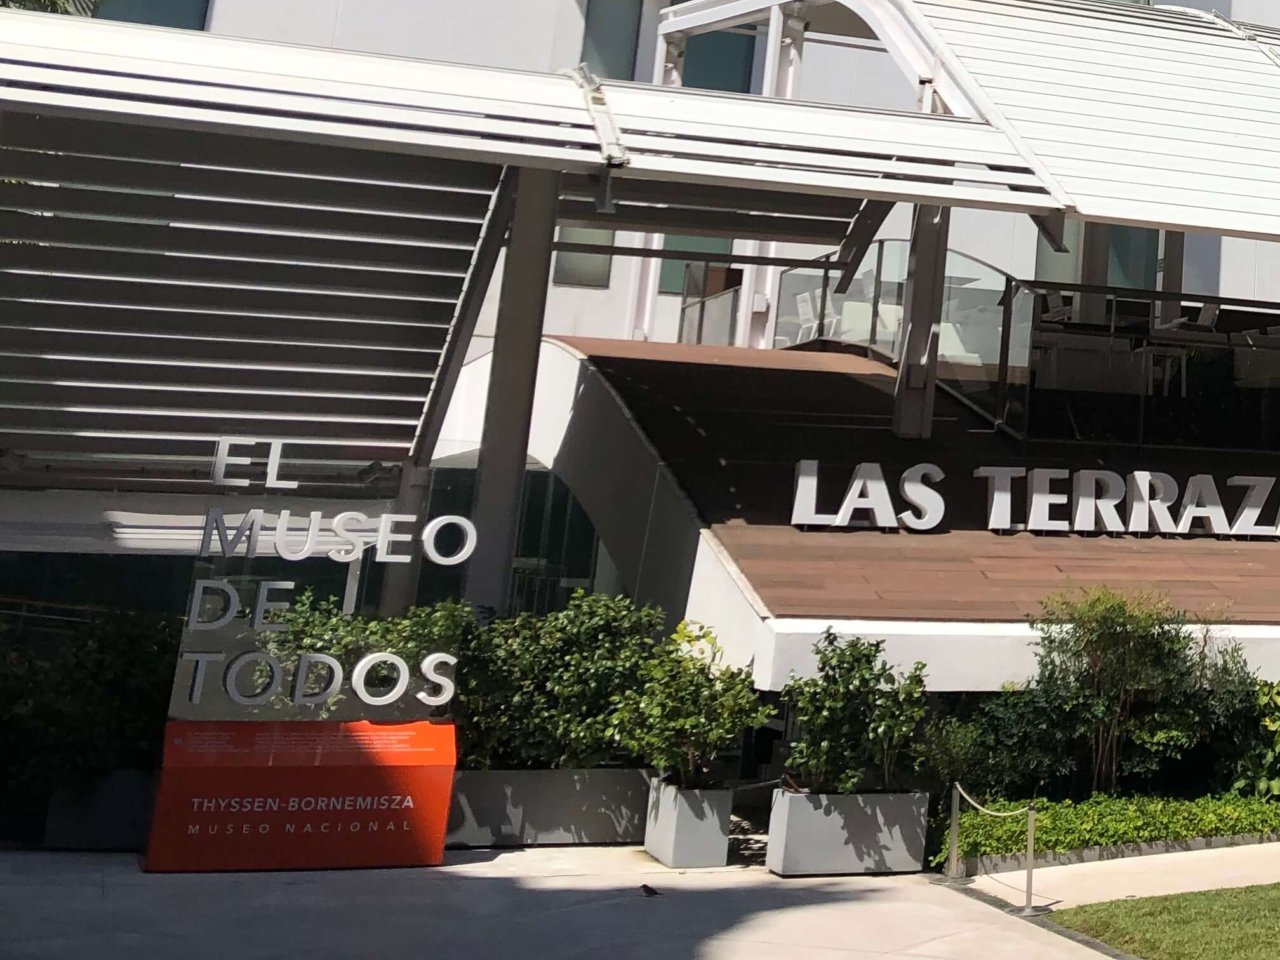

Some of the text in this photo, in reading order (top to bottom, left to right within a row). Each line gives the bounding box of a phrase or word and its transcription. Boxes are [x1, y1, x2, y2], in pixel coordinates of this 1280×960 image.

[211, 437, 299, 488] EL
[791, 459, 945, 531] LAS
[200, 507, 477, 565] MUSEO
[187, 579, 295, 632] DE
[181, 651, 458, 706] TODOS
[188, 821, 411, 835] MUSEO NACIONAL
[191, 795, 414, 812] THYSSEN-BORNEMISZA
